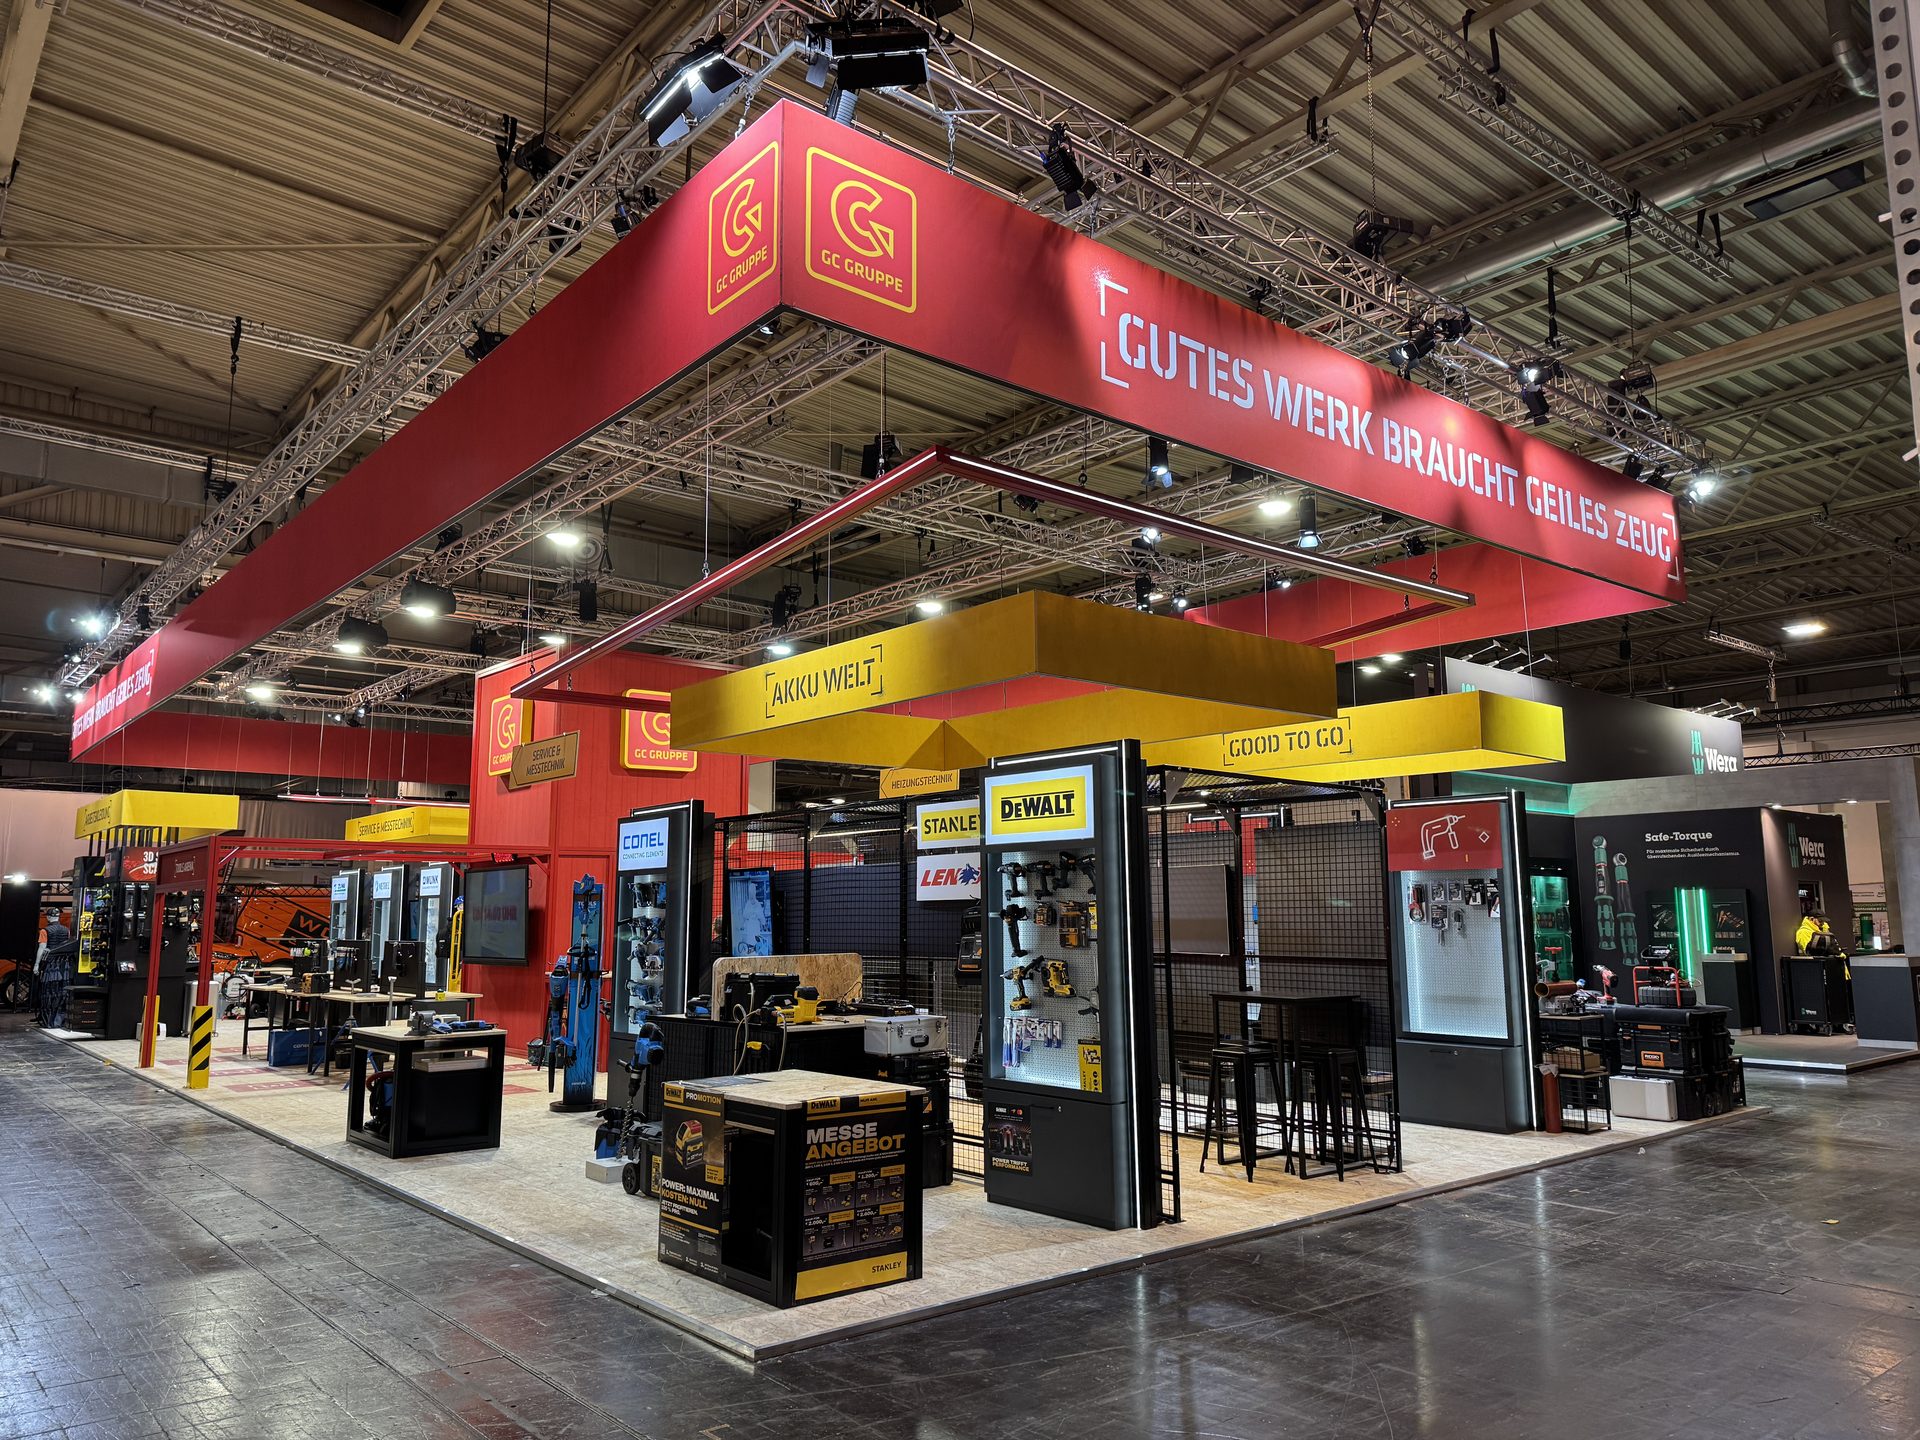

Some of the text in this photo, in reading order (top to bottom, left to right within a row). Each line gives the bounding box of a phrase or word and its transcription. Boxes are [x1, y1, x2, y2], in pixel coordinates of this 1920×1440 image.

[716, 245, 767, 293] GC GRUPPE
[821, 249, 903, 293] GC GRUPPE
[1118, 312, 1672, 562] GUTES WERK BRAUCHT GEILES ZEUG
[116, 673, 135, 706] GEILES
[134, 661, 151, 694] ZEUG
[772, 658, 875, 706] AKKU WELT
[1229, 726, 1344, 758] GOOD TO GO
[492, 755, 499, 765] GC
[532, 745, 560, 761] SERVICE &
[635, 749, 688, 761] GC GRUPPE
[1704, 747, 1738, 772] Wera
[526, 757, 565, 776] MESSTECHNIK
[891, 773, 953, 789] HEIZUNGSTECHNIK
[1001, 793, 1075, 819] DEWALT
[359, 822, 376, 836] SERVICE
[380, 817, 413, 833] MESSTECHNIK
[624, 832, 664, 850] CONEL
[1645, 831, 1713, 842] Safe-Torque
[623, 850, 664, 860] CONNECTING ELEMENTS
[1799, 836, 1825, 858] Wera
[143, 851, 154, 862] 3D
[685, 1092, 722, 1105] PROMOTION
[811, 1100, 837, 1110] DEWALT
[806, 1122, 878, 1145] MESSE
[805, 1133, 906, 1161] ANGEBOT
[992, 1156, 1028, 1167] POWER TRIFFT
[992, 1161, 1030, 1172] PERFORMANCE
[661, 1178, 720, 1203] POWER: MAXIMAL.
[661, 1188, 689, 1204] KOSTEN:
[871, 1261, 902, 1273] STANLEY
